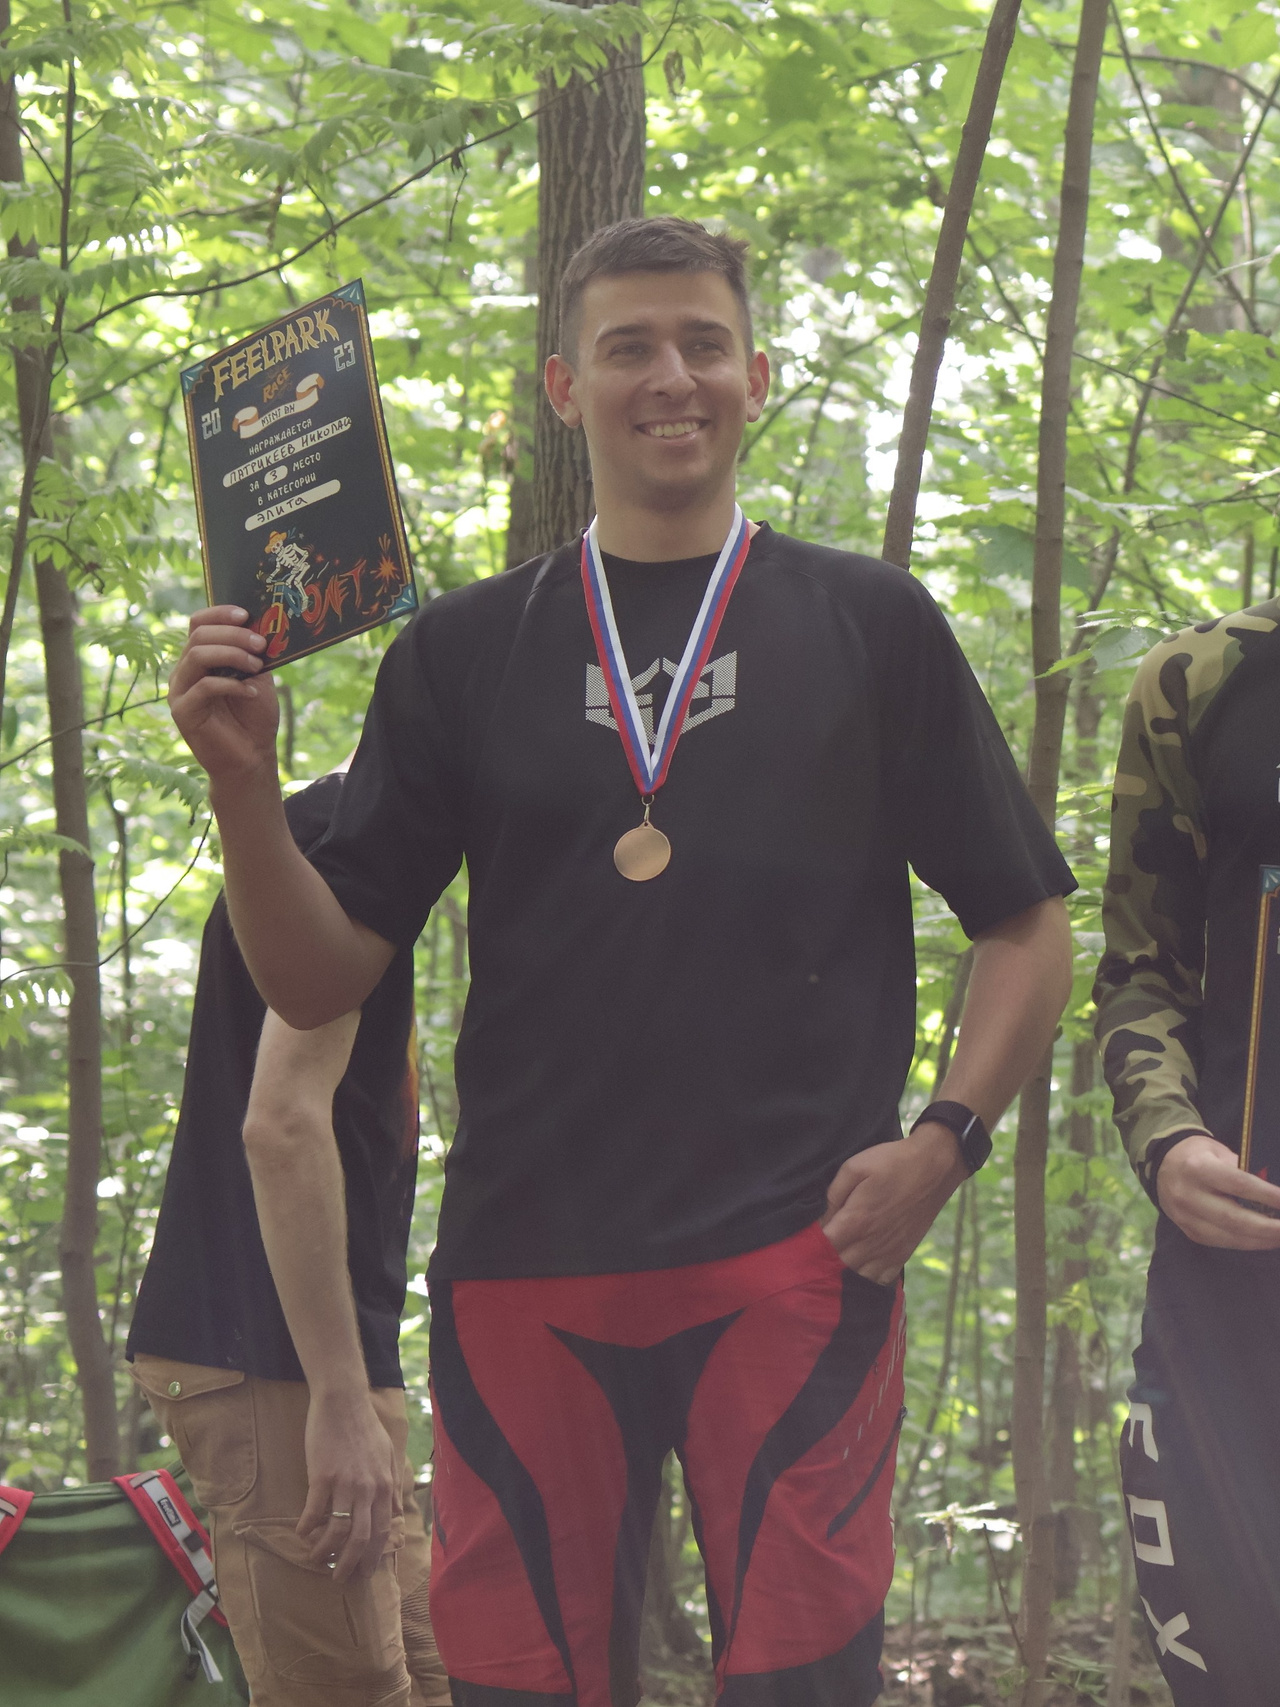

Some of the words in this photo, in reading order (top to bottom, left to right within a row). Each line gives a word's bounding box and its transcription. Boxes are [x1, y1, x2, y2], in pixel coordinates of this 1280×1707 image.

[212, 308, 340, 403] FEELPARK
[333, 340, 357, 372] 23
[263, 365, 291, 403] RACE
[201, 407, 223, 441] 20
[248, 418, 313, 456] НАГРАЖДАЕТСЯ
[261, 408, 281, 428] MINI
[229, 443, 296, 485] ПАТРИКЕЕВ
[249, 480, 260, 493] ЗА
[269, 469, 278, 481] 3
[292, 452, 321, 472] МЕСТО
[257, 496, 264, 506] В
[267, 472, 317, 502] КАТЕГОРИИ
[1126, 1402, 1208, 1672] FOX
